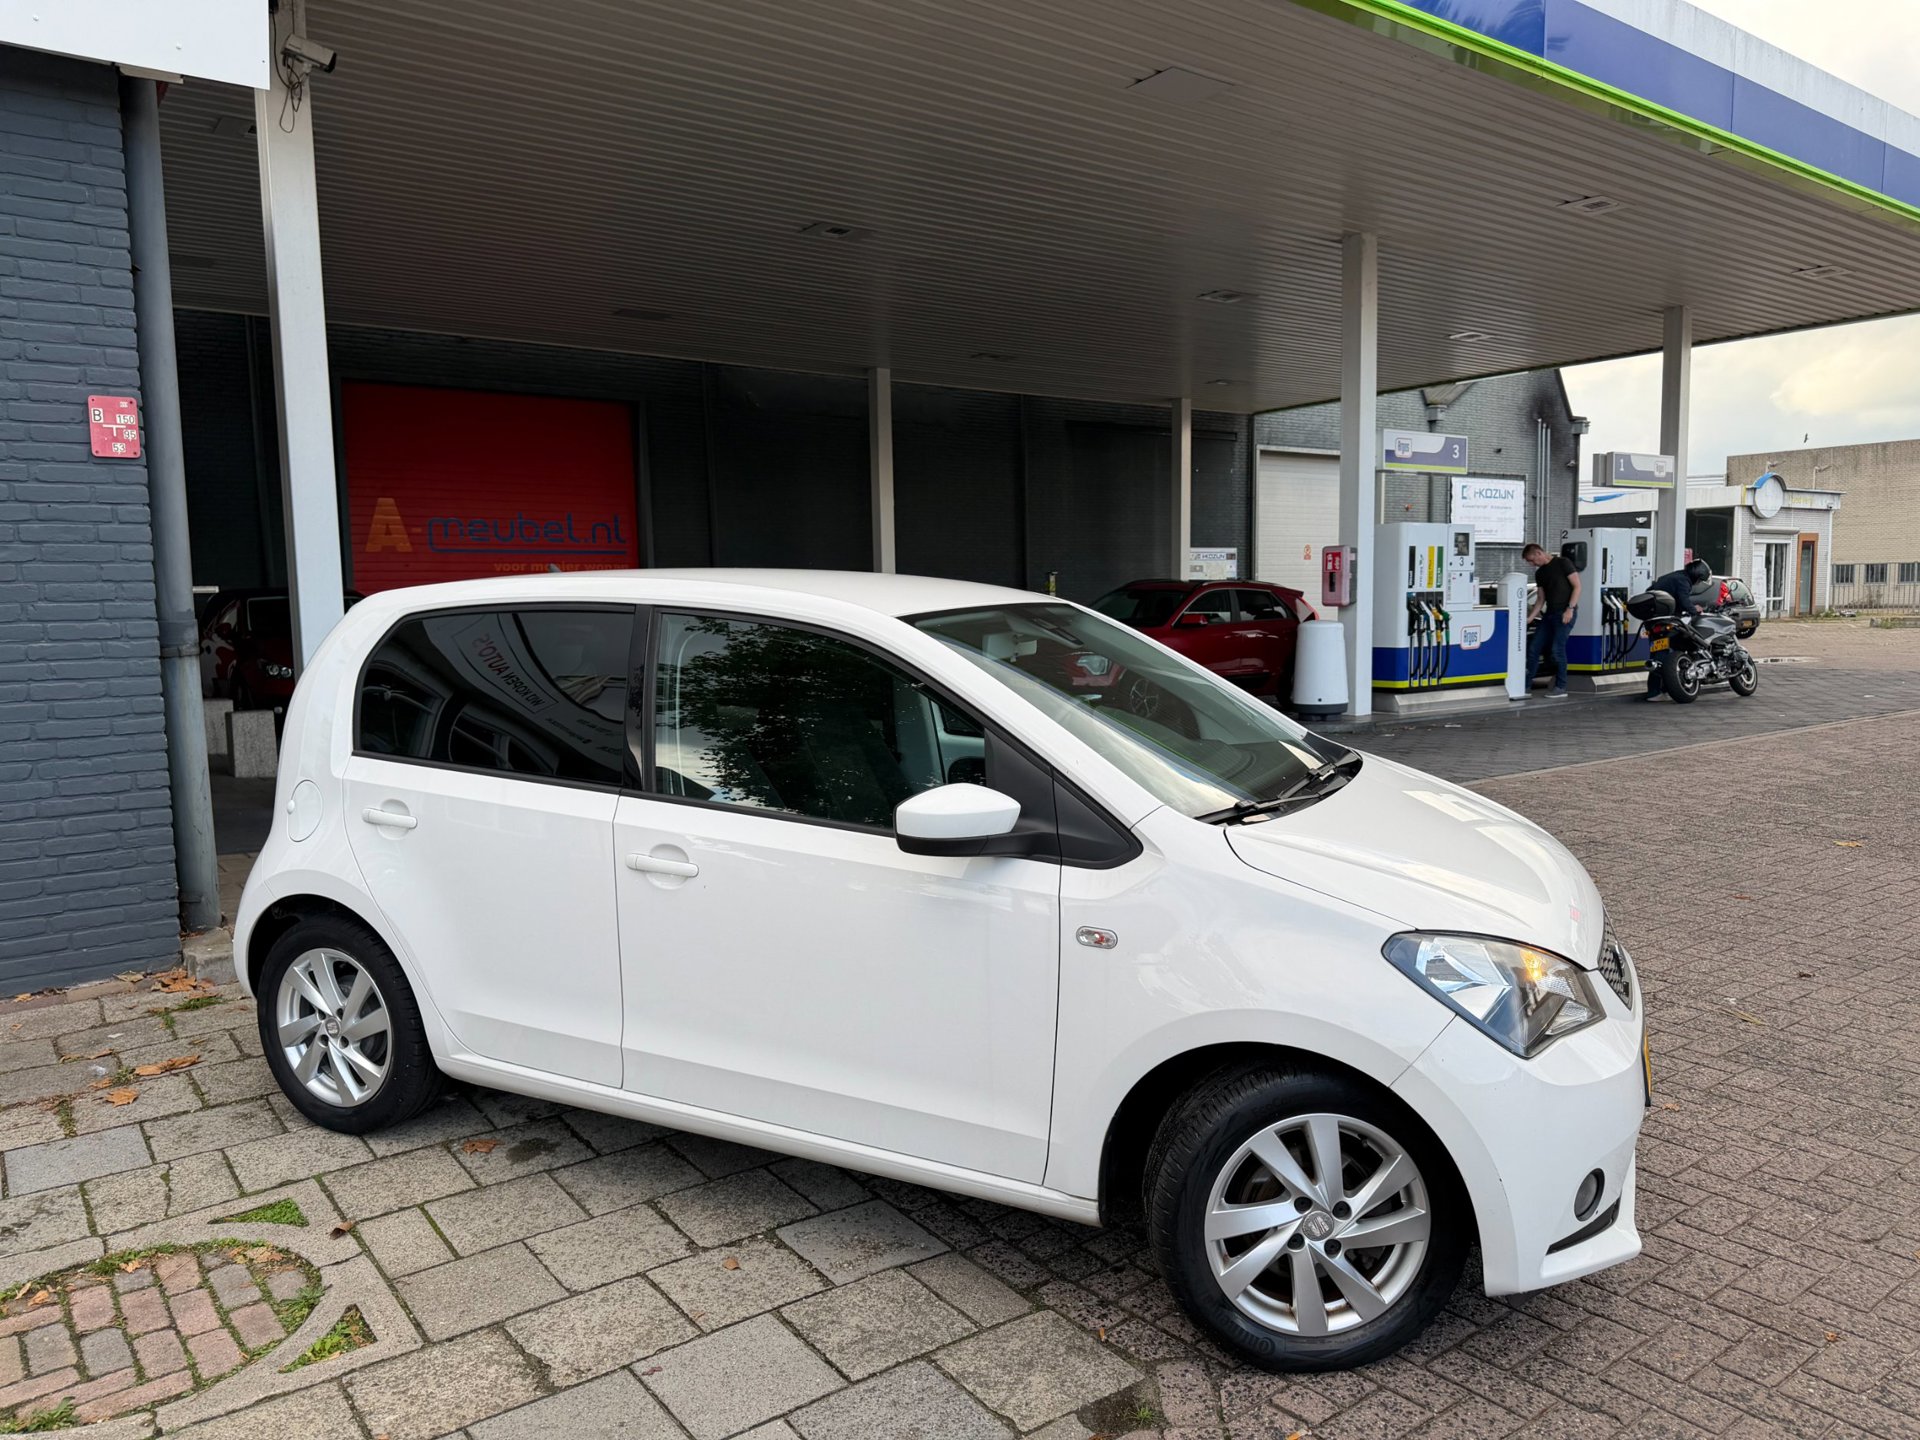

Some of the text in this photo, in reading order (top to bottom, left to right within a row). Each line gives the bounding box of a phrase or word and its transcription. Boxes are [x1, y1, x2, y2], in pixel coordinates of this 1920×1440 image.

[92, 408, 102, 422] B
[117, 414, 135, 424] 150
[1452, 444, 1460, 459] 3
[1619, 458, 1625, 472] 1
[1561, 529, 1569, 539] 2
[1588, 529, 1594, 538] 1
[1459, 556, 1464, 567] 3
[494, 563, 526, 572] voor
